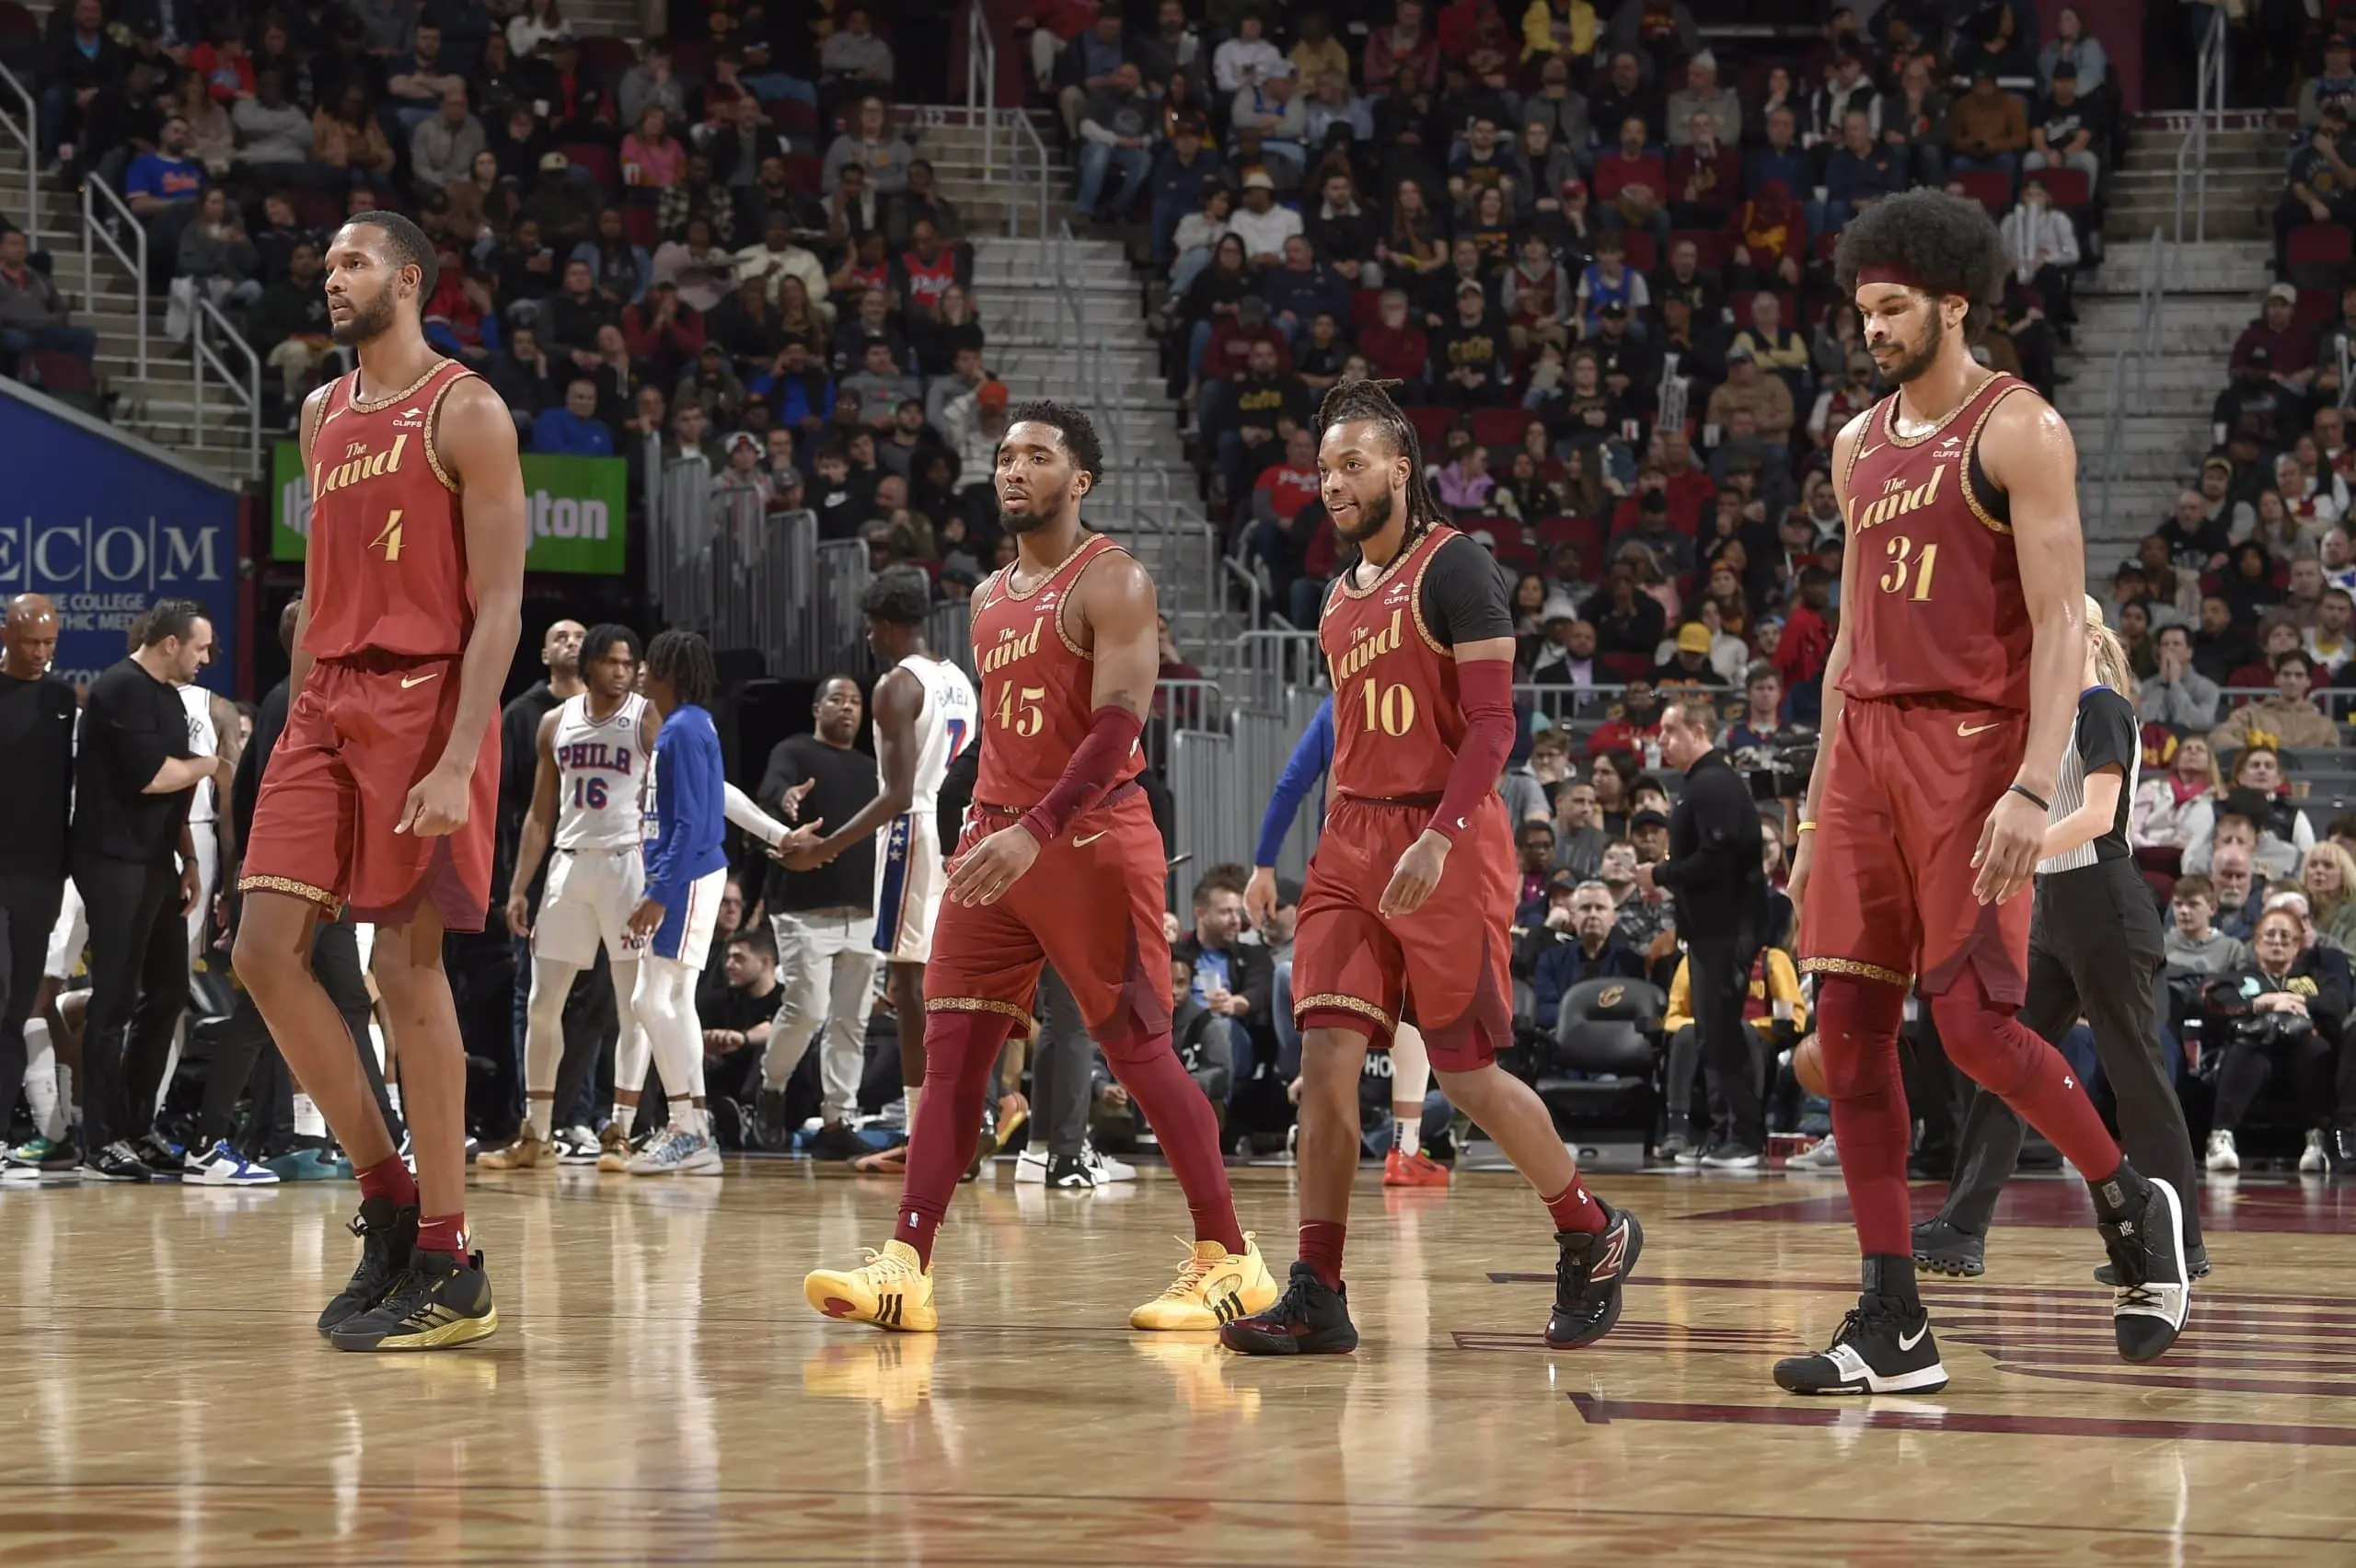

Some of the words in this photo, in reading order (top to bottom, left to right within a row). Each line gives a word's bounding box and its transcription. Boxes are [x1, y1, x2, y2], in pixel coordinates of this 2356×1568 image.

[393, 420, 423, 428] CLIFFS
[346, 442, 367, 458] The
[1933, 450, 1960, 458] CLIFFS
[313, 433, 409, 503] Land
[1848, 464, 1946, 538] Land
[1883, 478, 1907, 494] The
[368, 510, 407, 561] 4
[1880, 536, 1938, 602] 31
[1034, 604, 1055, 612] CLIFFS
[1383, 594, 1410, 605] CLIFFS
[974, 617, 1045, 679] Land
[999, 627, 1016, 642] The
[1327, 608, 1403, 692] Land
[1350, 626, 1369, 644] The
[991, 680, 1045, 737] 45
[1358, 678, 1415, 736] 10
[558, 743, 631, 776] PHILA
[945, 719, 967, 770] 7
[574, 777, 608, 810] 16
